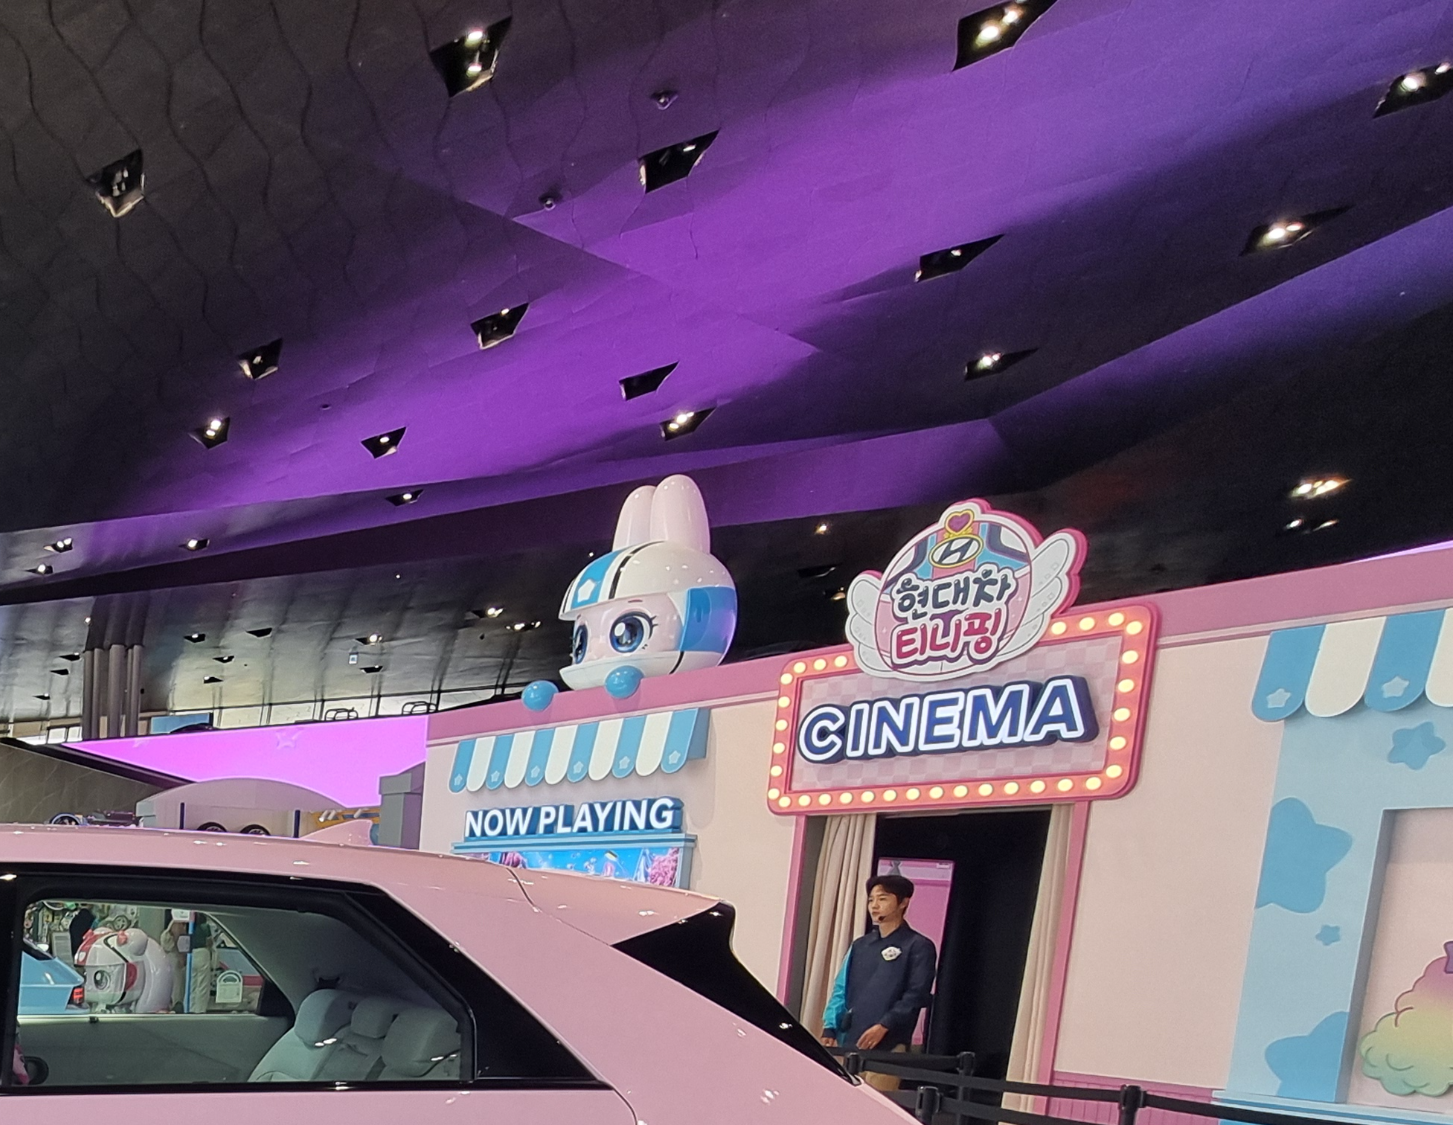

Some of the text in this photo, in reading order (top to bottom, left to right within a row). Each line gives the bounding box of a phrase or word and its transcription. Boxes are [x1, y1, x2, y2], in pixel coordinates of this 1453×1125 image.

[895, 568, 1013, 622] 현대차
[894, 608, 1004, 660] 티니핑
[797, 677, 1089, 763] CINEMA
[464, 797, 675, 837] NOW PLAYING
